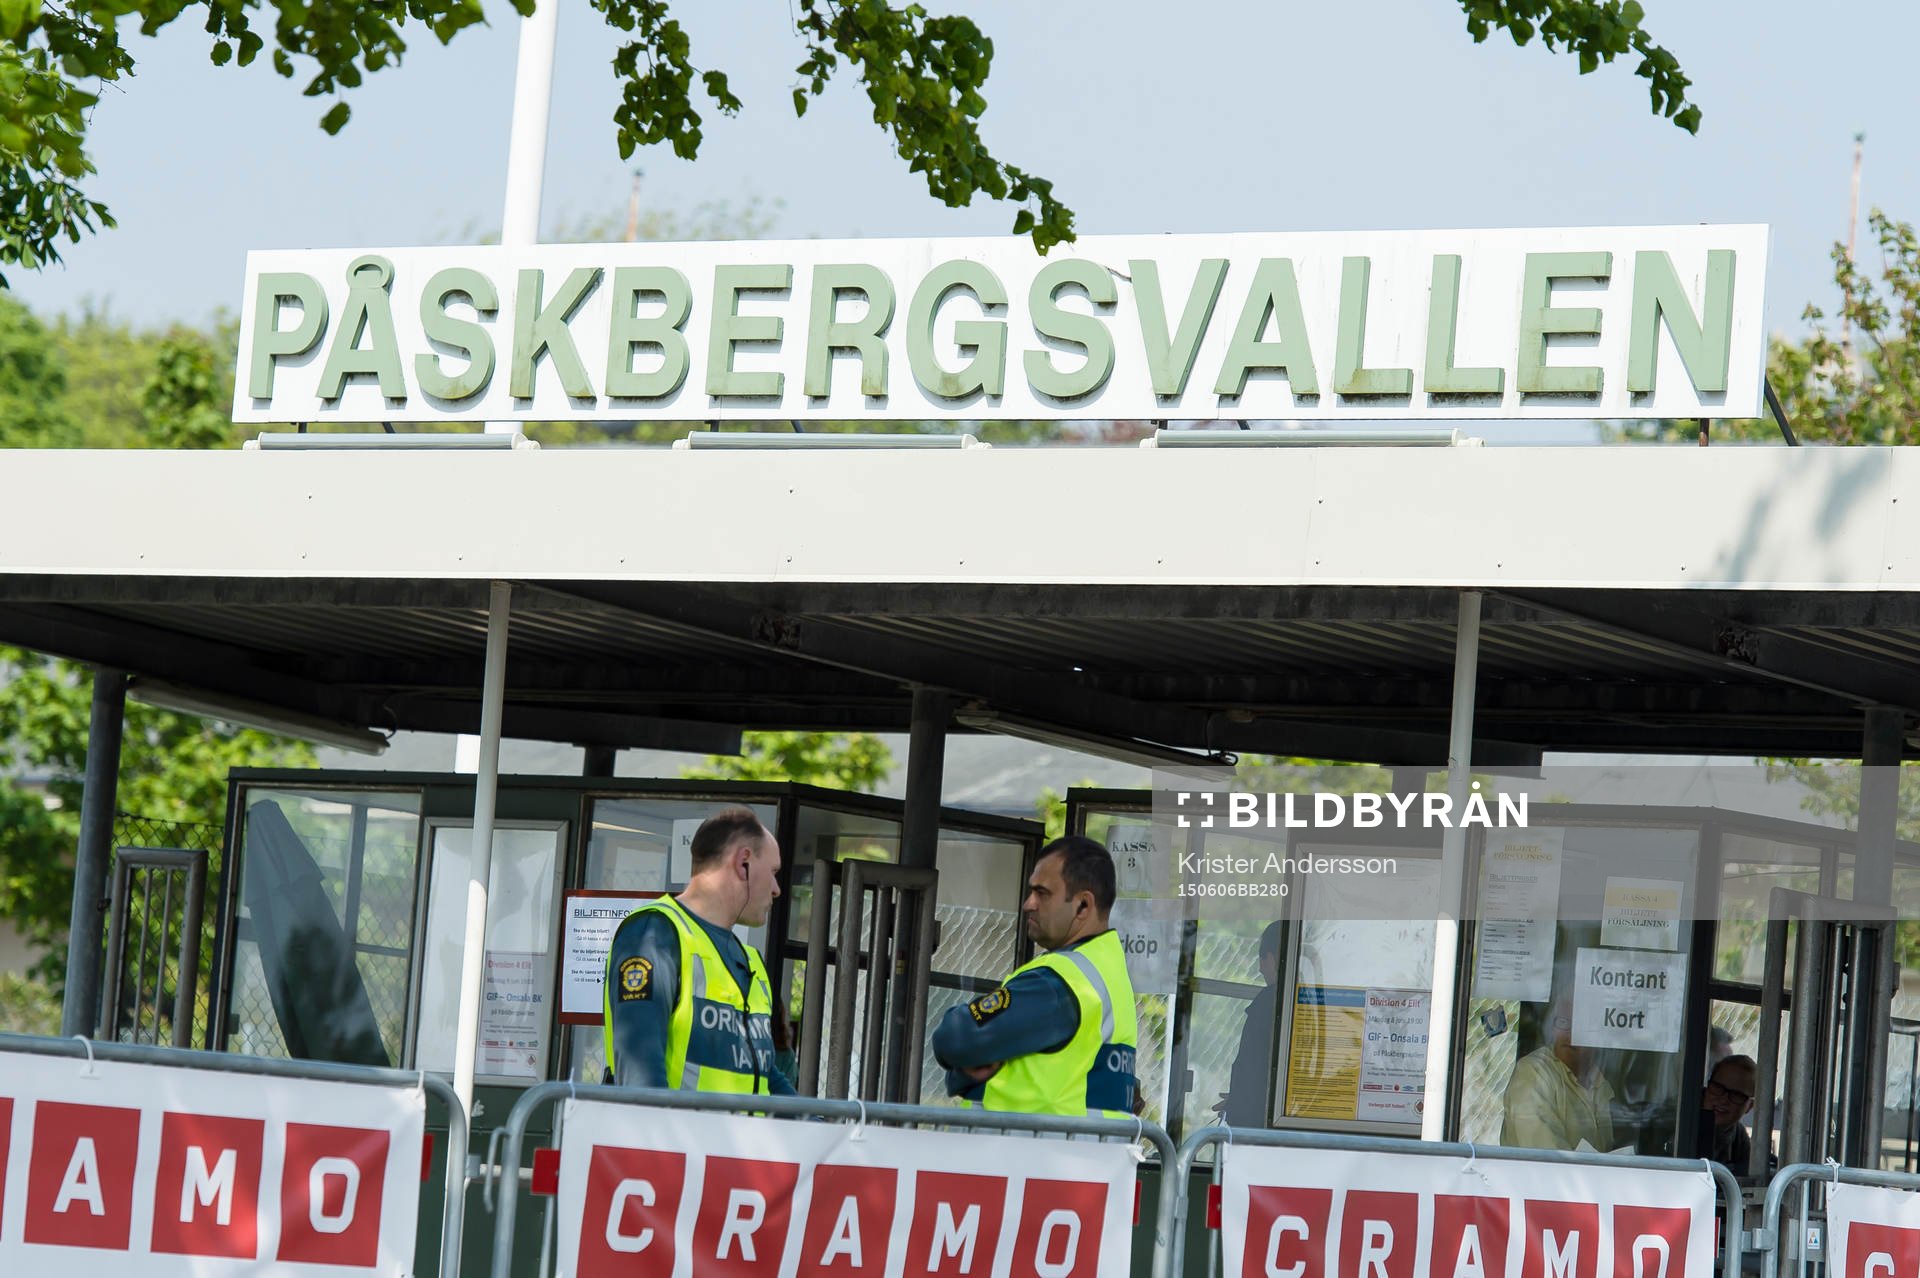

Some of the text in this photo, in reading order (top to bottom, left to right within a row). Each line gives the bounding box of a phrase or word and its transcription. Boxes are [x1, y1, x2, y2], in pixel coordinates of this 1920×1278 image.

[248, 249, 1736, 401] PÅSKBERGSVALLEN
[1112, 841, 1157, 853] KASSA
[1128, 858, 1136, 868] 3
[574, 908, 632, 918] BILJETTINFO
[1121, 934, 1158, 959] köp
[1590, 966, 1667, 990] Kontant
[1369, 997, 1400, 1008] Division
[1604, 1007, 1645, 1029] Kort
[1367, 1032, 1381, 1041] GIF
[1390, 1033, 1419, 1044] Onsala
[1421, 1034, 1427, 1045] B
[605, 1178, 1082, 1278] CRAMO
[1265, 1215, 1671, 1278] CRAMO
